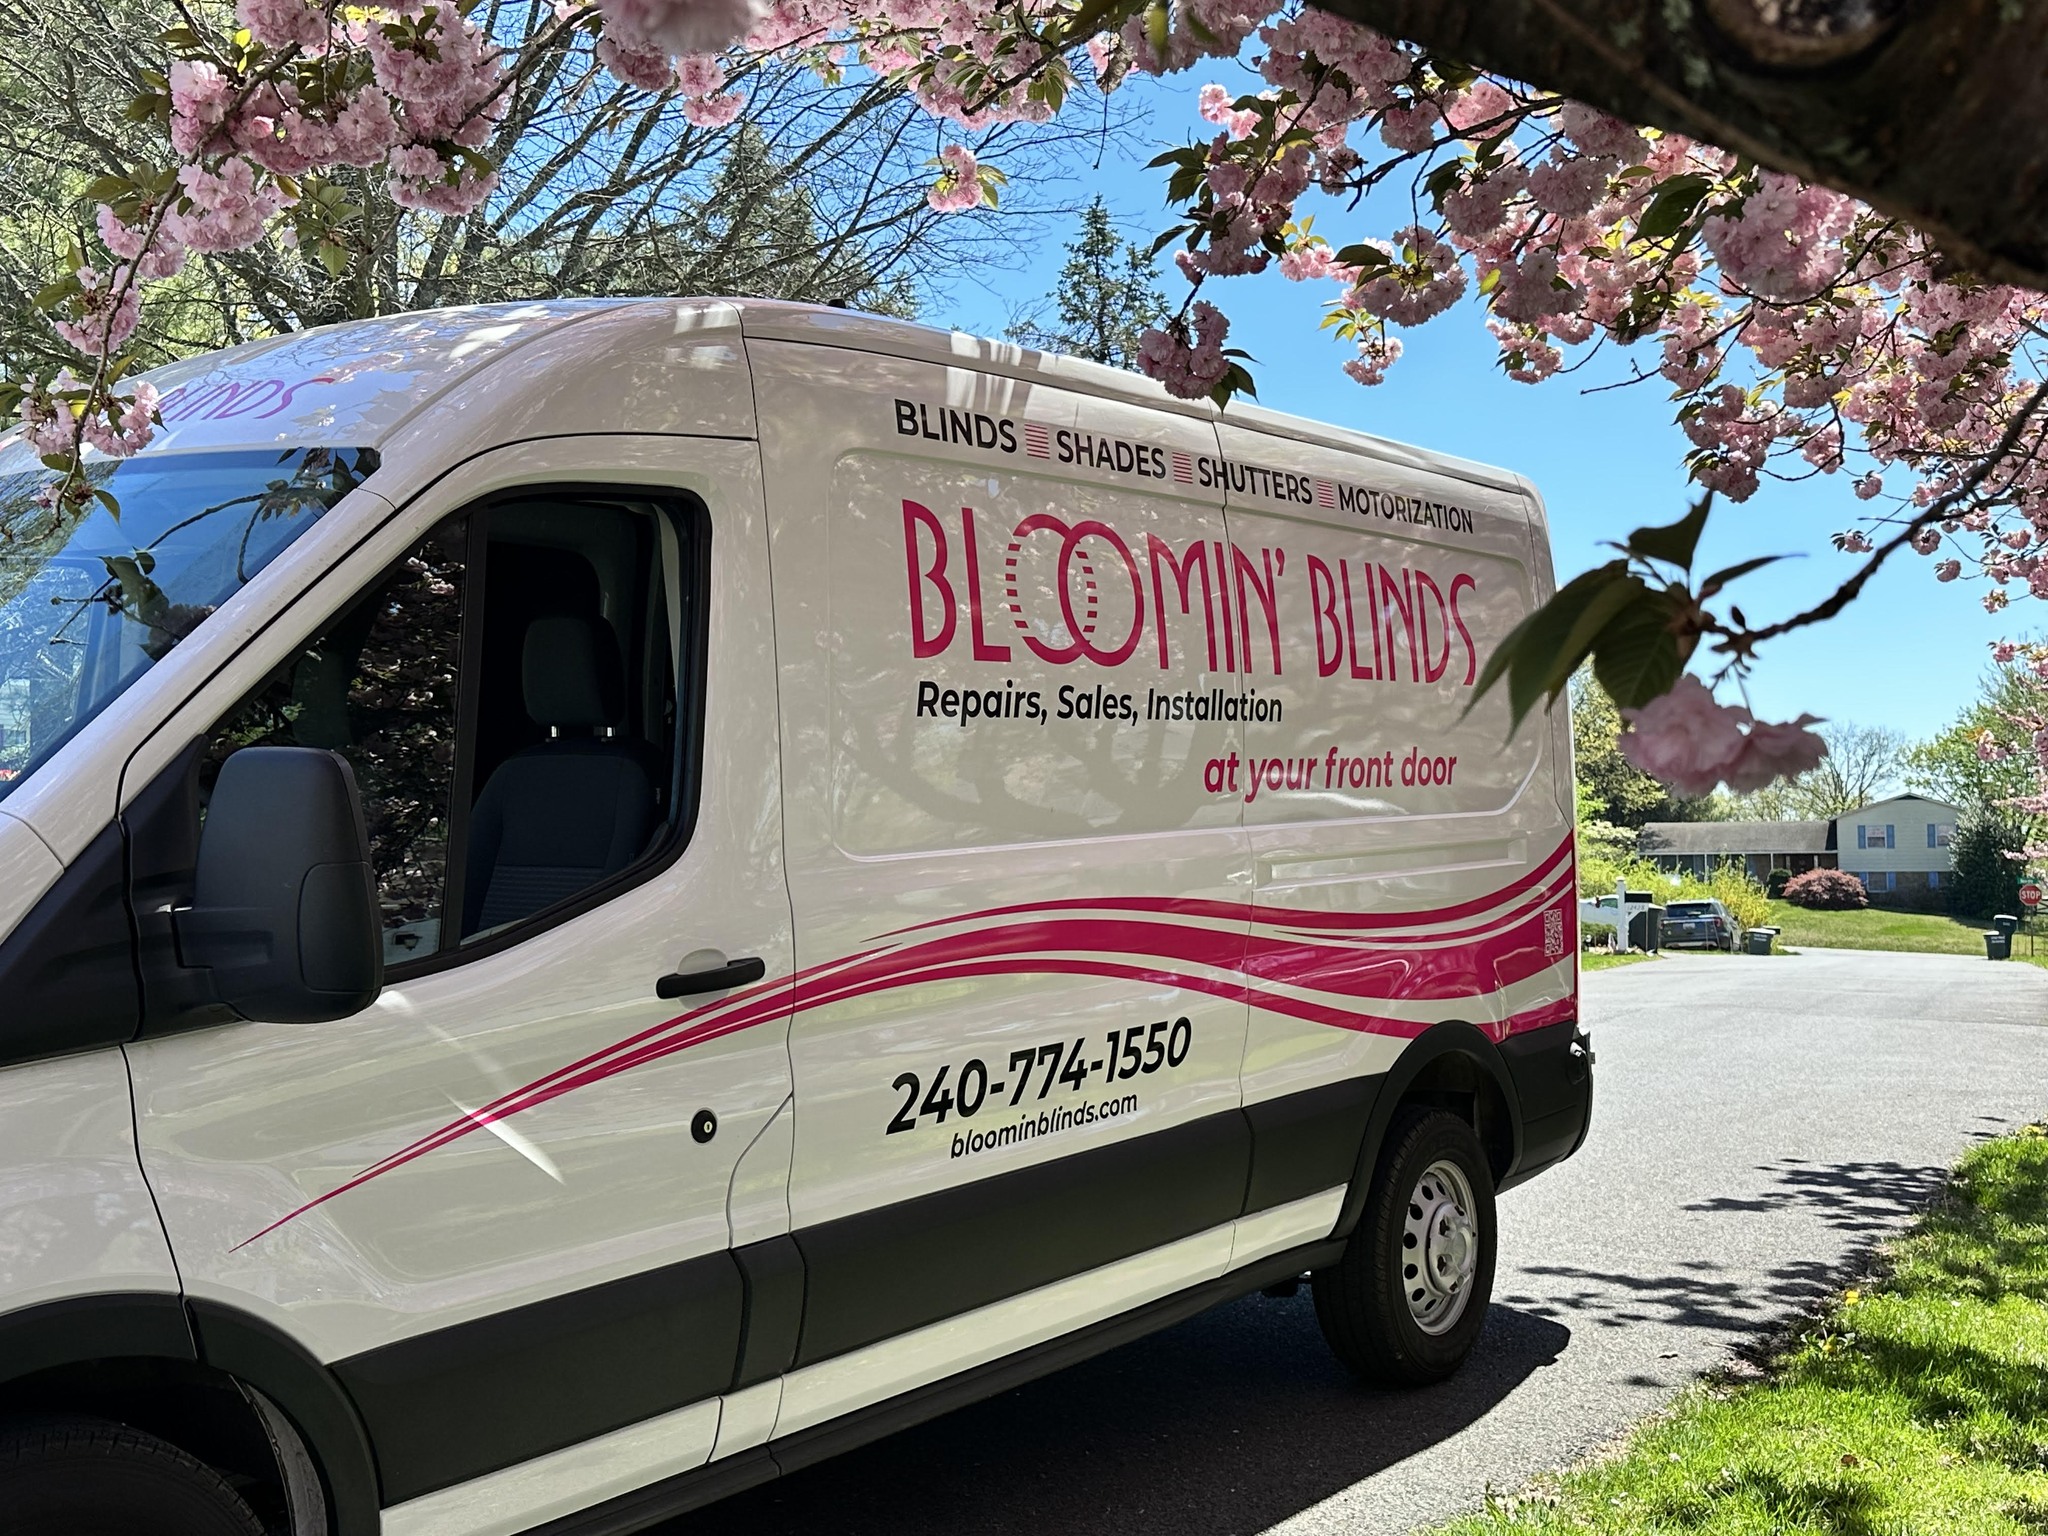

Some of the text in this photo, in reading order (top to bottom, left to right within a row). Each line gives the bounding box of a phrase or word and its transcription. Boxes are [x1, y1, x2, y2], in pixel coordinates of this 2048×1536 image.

[894, 398, 1474, 534] BLINDS SHADES SHUTTERS MOTORIZATION
[902, 498, 1476, 686] BLOOMIN' BLINDS
[916, 679, 1282, 727] Repairs, Sales, Installation
[1203, 746, 1458, 804] at your front door
[2021, 890, 2041, 900] STOP
[885, 1016, 1193, 1136] 240-774-1550
[950, 1093, 1138, 1160] bloominblinds.com
